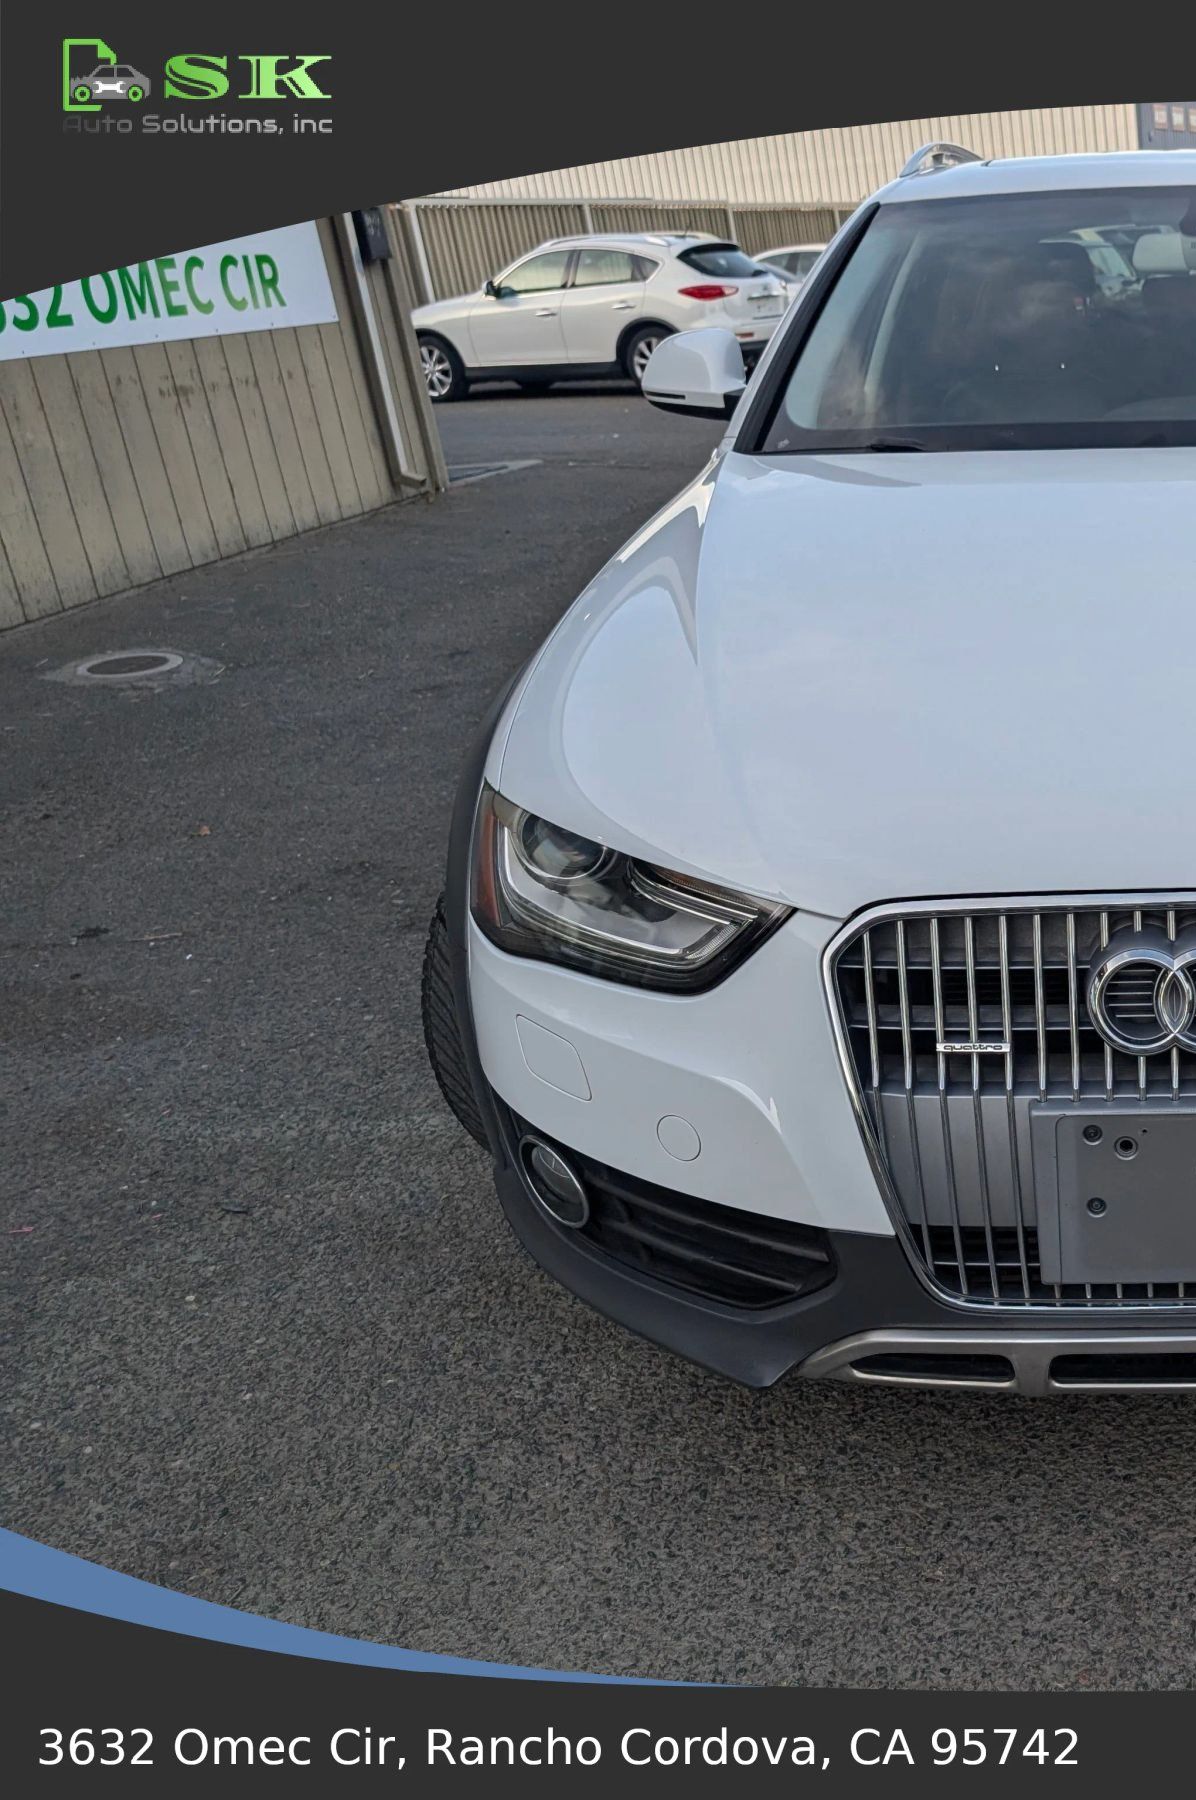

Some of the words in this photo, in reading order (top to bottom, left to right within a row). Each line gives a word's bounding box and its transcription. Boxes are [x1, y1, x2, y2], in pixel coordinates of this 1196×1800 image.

[0, 285, 74, 334] 32
[80, 255, 215, 324] OMEC
[219, 253, 288, 312] CIR
[943, 1044, 1003, 1052] quattro
